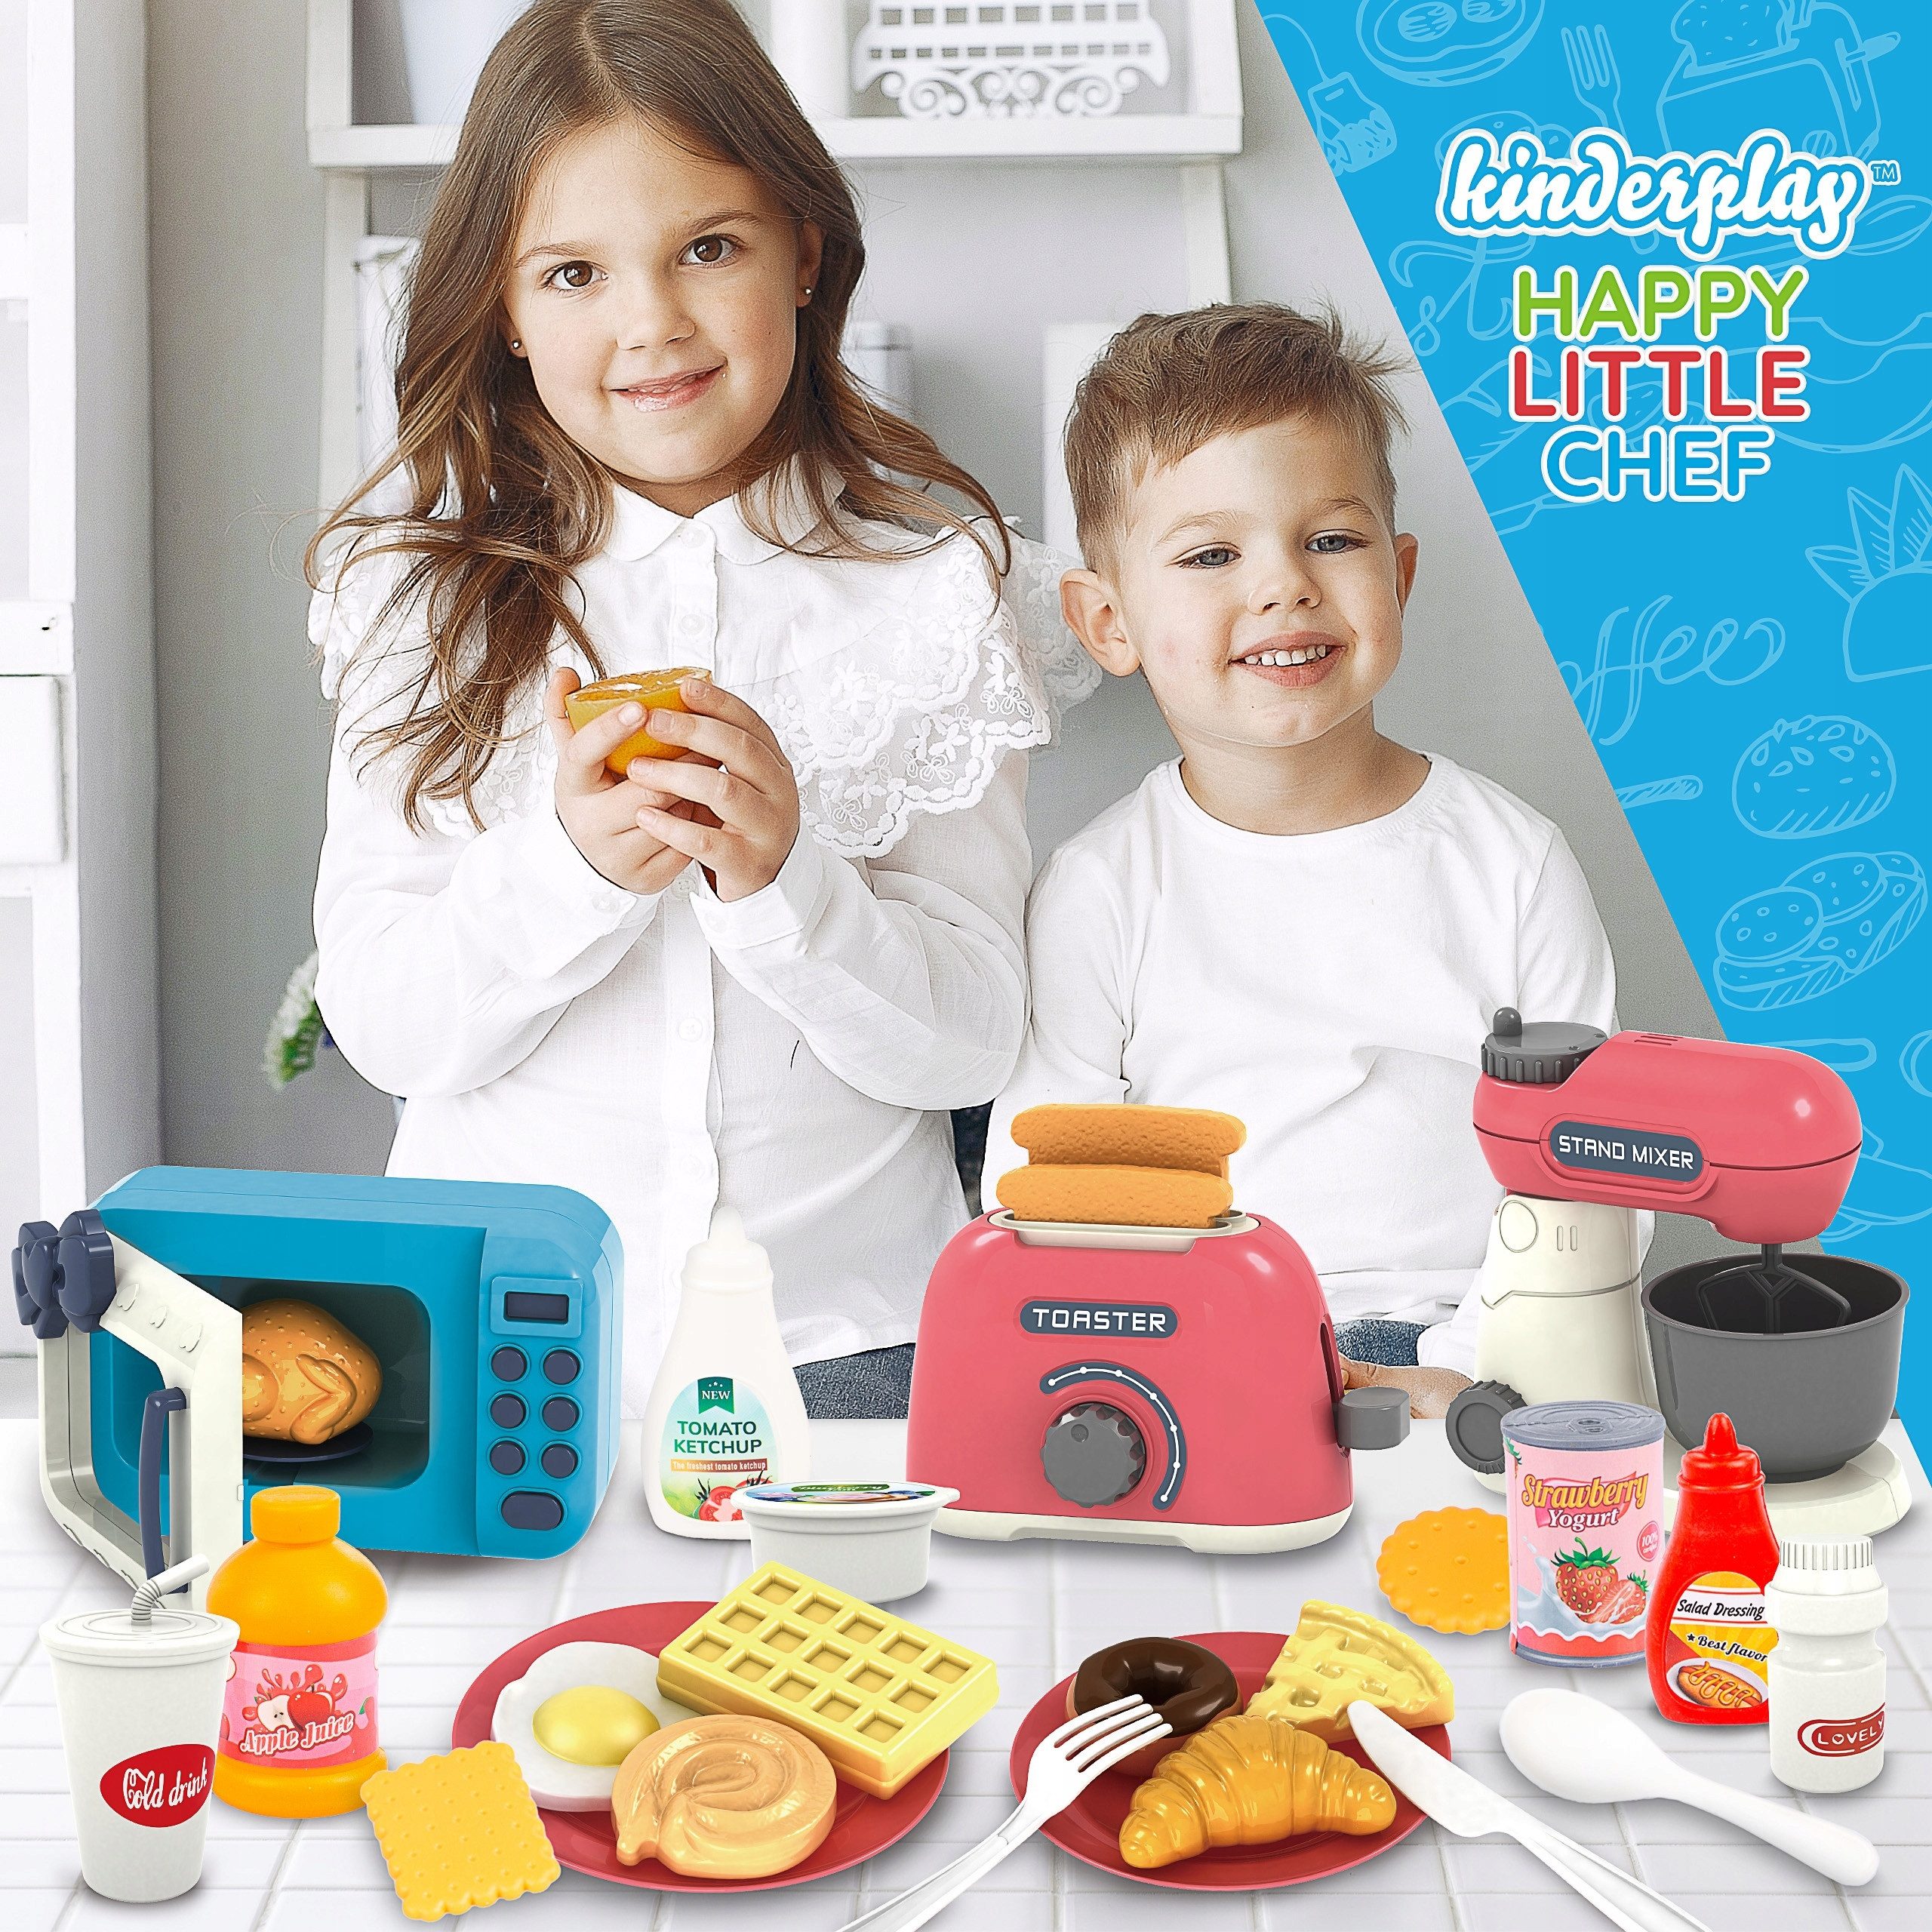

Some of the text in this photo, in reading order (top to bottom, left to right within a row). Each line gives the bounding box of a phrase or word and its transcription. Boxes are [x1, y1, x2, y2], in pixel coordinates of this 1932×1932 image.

[1558, 1134, 1694, 1170] STAND MIXER
[1032, 1308, 1166, 1333] TOASTER
[701, 1390, 731, 1400] NEW
[677, 1420, 757, 1435] TOMATO
[674, 1438, 762, 1454] KETCHUP
[715, 1463, 738, 1471] tomato
[740, 1461, 766, 1470] ketchup
[1521, 1473, 1649, 1510] Strawberry
[1548, 1507, 1620, 1533] Yogurt
[1677, 1599, 1765, 1621] Salad Dressing
[1697, 1635, 1768, 1662] Best flavor
[239, 1712, 355, 1755] Apple Juice
[122, 1756, 208, 1810] Cold drink
